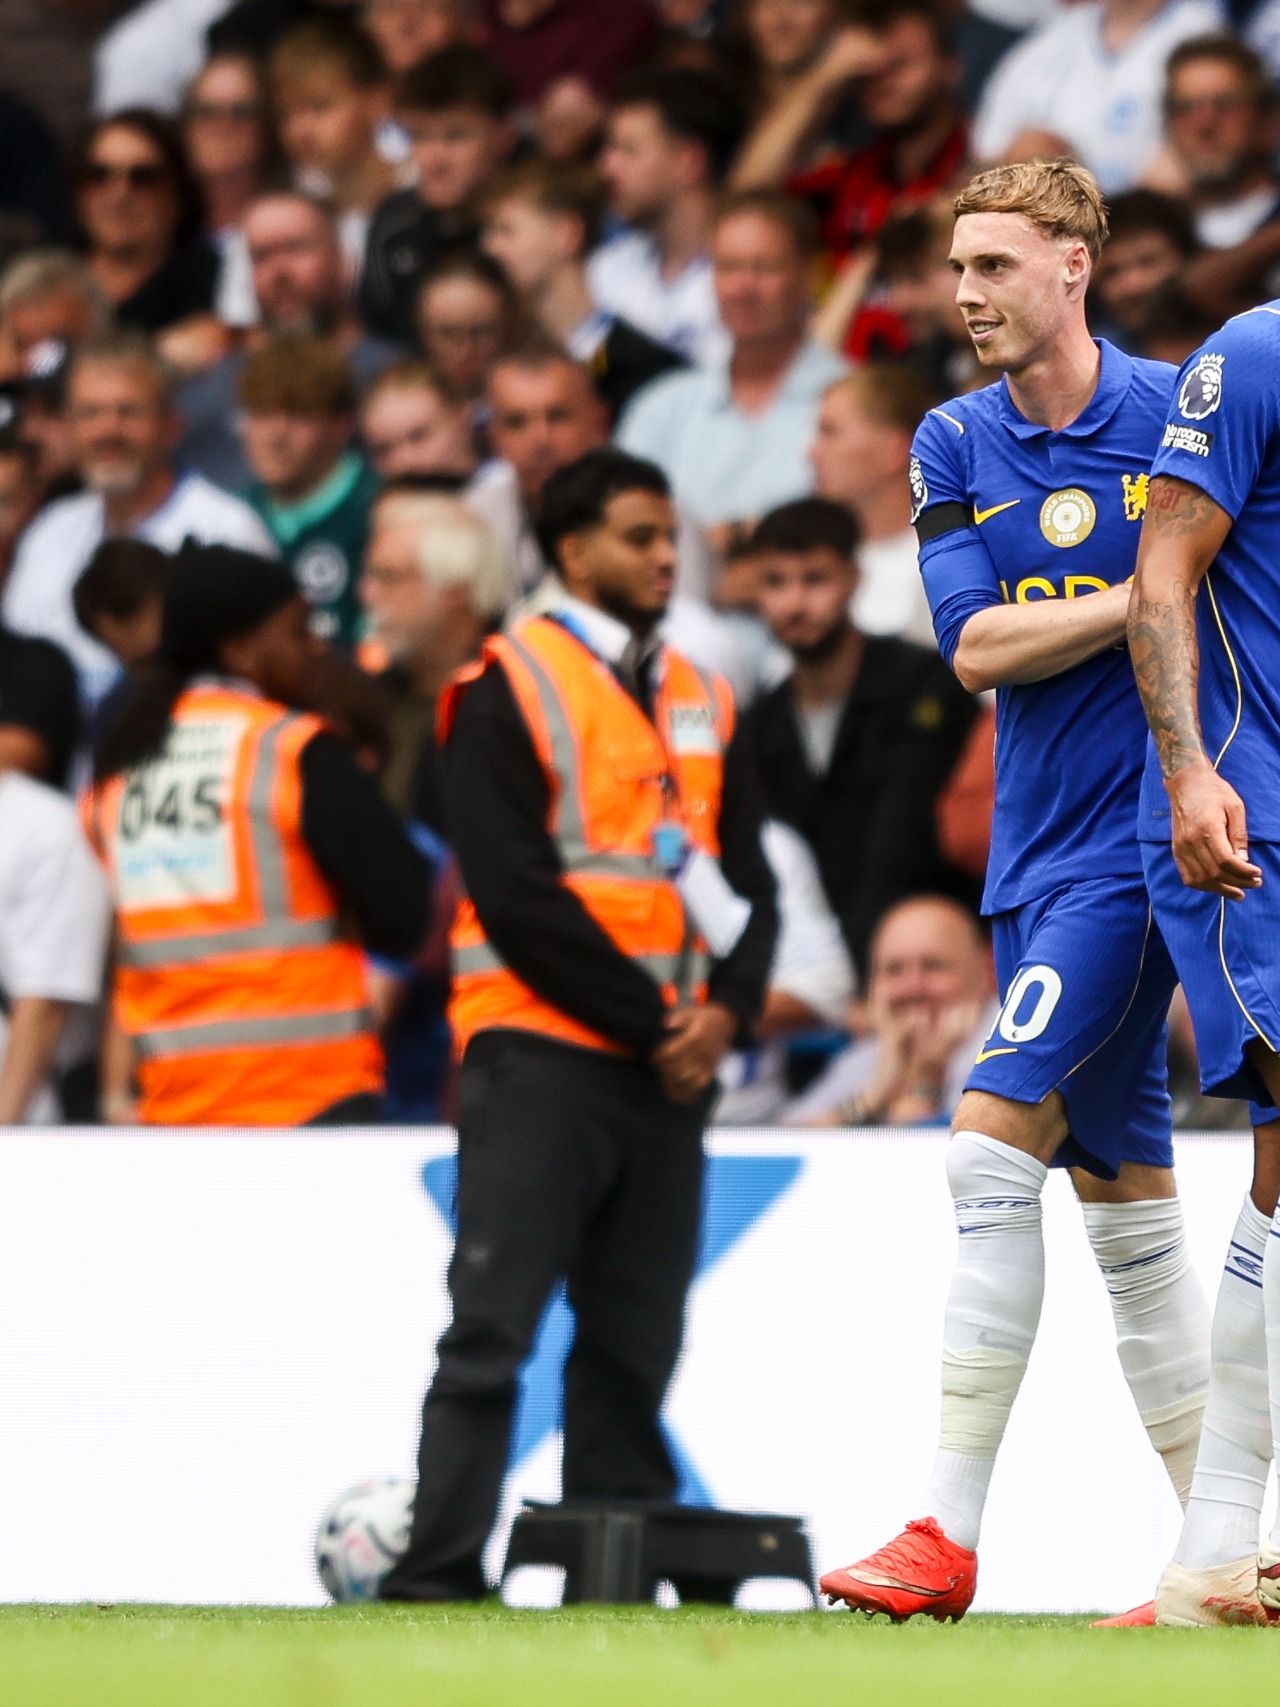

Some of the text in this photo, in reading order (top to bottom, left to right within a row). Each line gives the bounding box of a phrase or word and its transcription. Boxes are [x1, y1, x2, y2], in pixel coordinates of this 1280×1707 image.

[1177, 427, 1208, 445] room
[1044, 493, 1090, 527] WORLD CHAMPIONS
[1056, 532, 1078, 543] FIFA
[119, 775, 224, 844] 045
